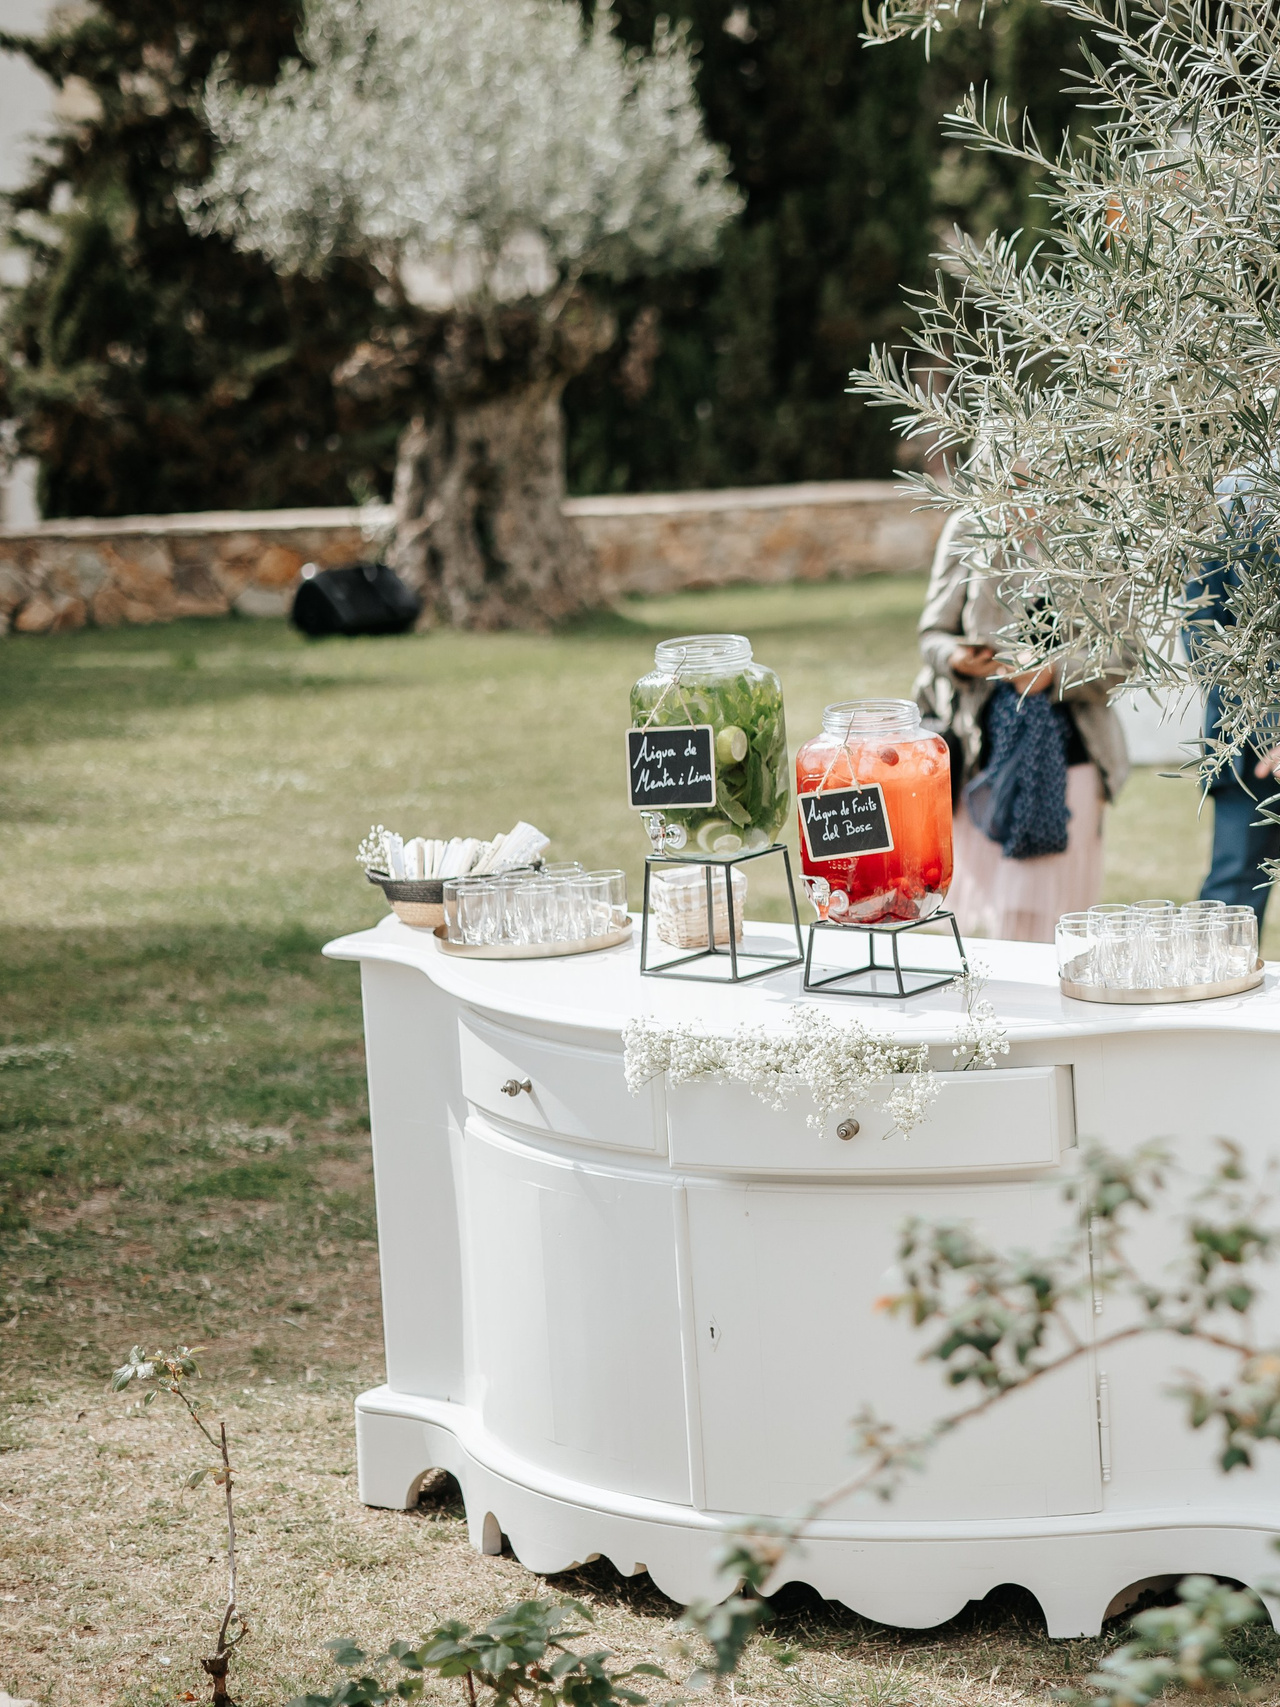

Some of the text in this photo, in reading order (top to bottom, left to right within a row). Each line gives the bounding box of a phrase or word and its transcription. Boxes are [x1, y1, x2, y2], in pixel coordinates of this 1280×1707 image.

[684, 739, 697, 757] de
[635, 766, 712, 793] Menta i Lima
[840, 800, 850, 816] de
[852, 796, 877, 814] Fruits
[822, 820, 873, 841] del Bosc
